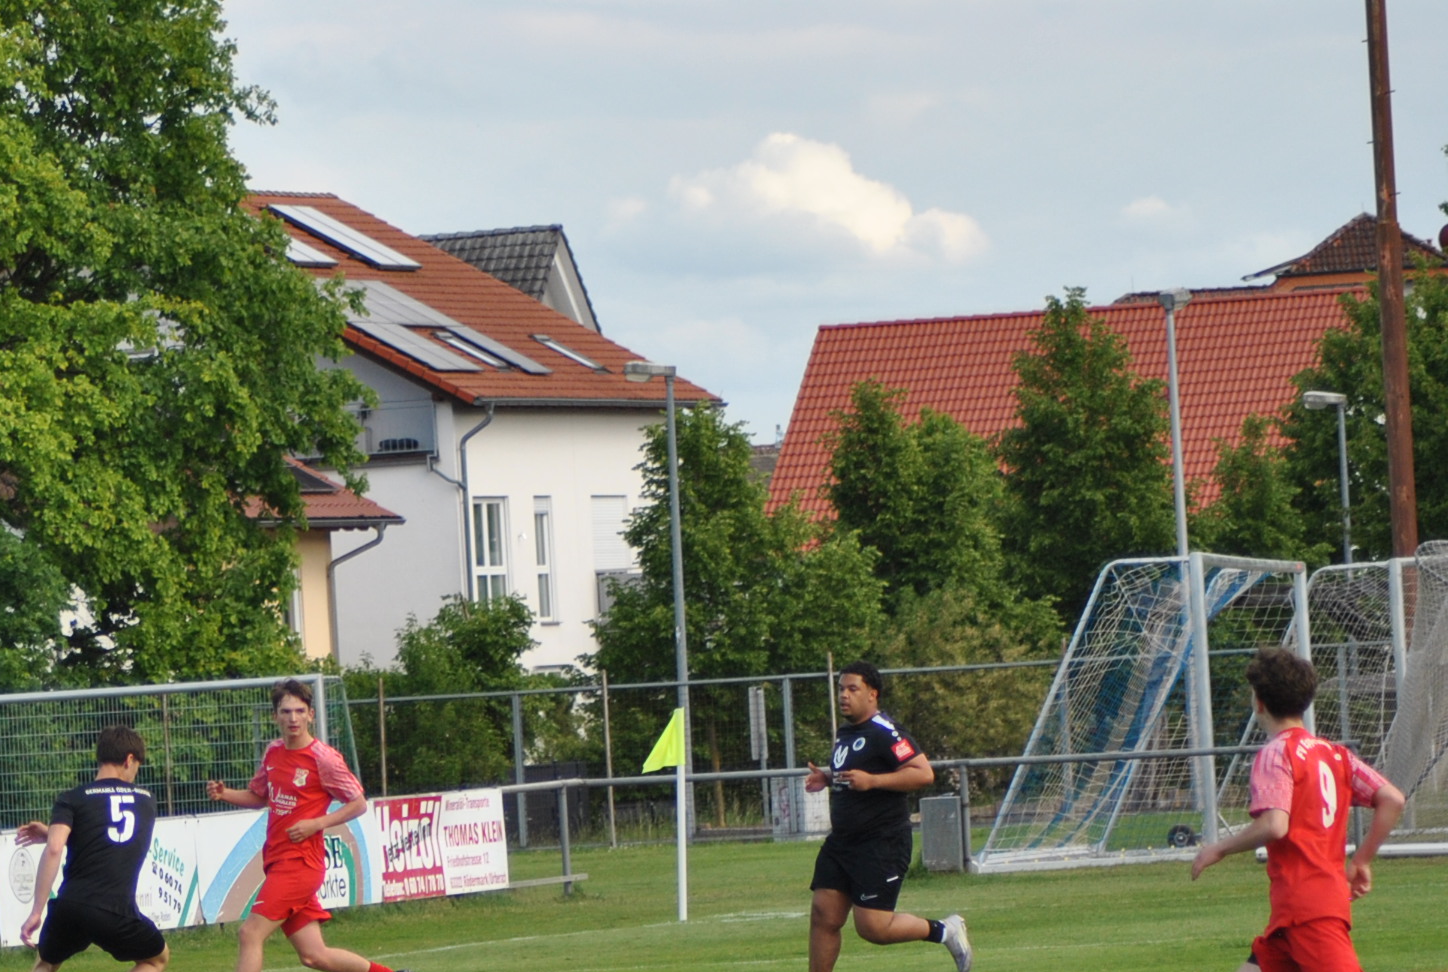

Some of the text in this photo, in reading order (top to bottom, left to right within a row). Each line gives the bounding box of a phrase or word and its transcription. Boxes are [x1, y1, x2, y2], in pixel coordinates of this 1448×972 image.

[108, 795, 135, 843] 5
[1318, 760, 1338, 829] 9
[375, 801, 442, 873] Heizöl
[443, 820, 503, 847] THOMAS KLEIN
